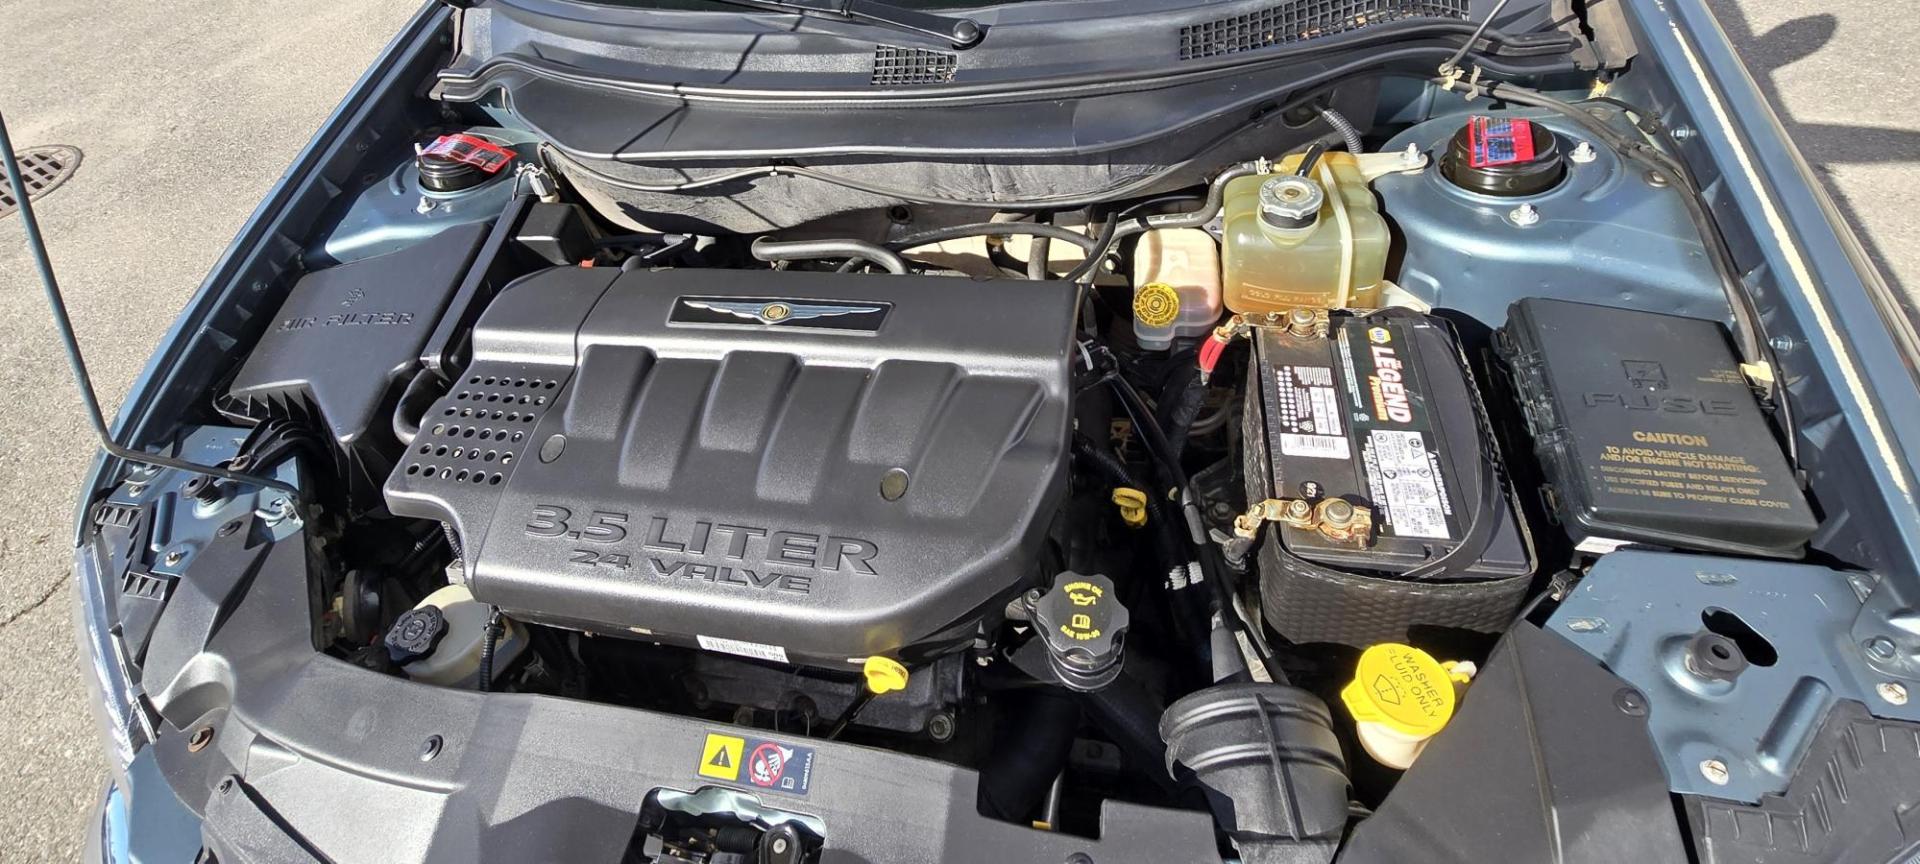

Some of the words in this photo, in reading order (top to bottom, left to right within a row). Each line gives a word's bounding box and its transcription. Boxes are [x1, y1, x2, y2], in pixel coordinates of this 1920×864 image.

[277, 317, 317, 332] AIR
[322, 312, 415, 328] FILTER
[1371, 345, 1412, 423] LEGEND
[1368, 375, 1389, 421] Premium
[1582, 392, 1740, 416] FUSE
[1632, 431, 1708, 447] CAUTION
[1600, 453, 1642, 463] AND/OR
[1642, 457, 1681, 467] ENGINE
[1682, 460, 1705, 468] NOT
[1606, 446, 1620, 454] TO
[1622, 447, 1654, 457] AVOID
[1654, 450, 1696, 460] VEHICLE
[1697, 453, 1746, 464] DAMAGE
[1603, 475, 1618, 483] USE
[1620, 477, 1659, 487] SPECIFIED
[1660, 480, 1684, 489] FUSES
[1686, 482, 1704, 490] AND
[1705, 484, 1737, 494] RELAYS
[1737, 487, 1760, 496] ONLY
[1653, 470, 1687, 478] BATTERY
[1688, 473, 1720, 482] BEFORE
[1720, 475, 1768, 486] SERVICING
[1673, 491, 1685, 499] TO
[1686, 493, 1728, 504] PROPERLY
[1729, 497, 1758, 506] CLOSE
[1759, 499, 1791, 510] COVER
[525, 503, 629, 544] 3.5
[643, 515, 879, 577] LITER
[569, 548, 632, 571] 24
[649, 557, 812, 595] VALVE
[1063, 582, 1092, 593] ENGINE
[1092, 585, 1104, 598] OIL
[1387, 648, 1413, 683] FLUID
[1410, 685, 1438, 718] ONLY
[1402, 652, 1444, 707] WASHER
